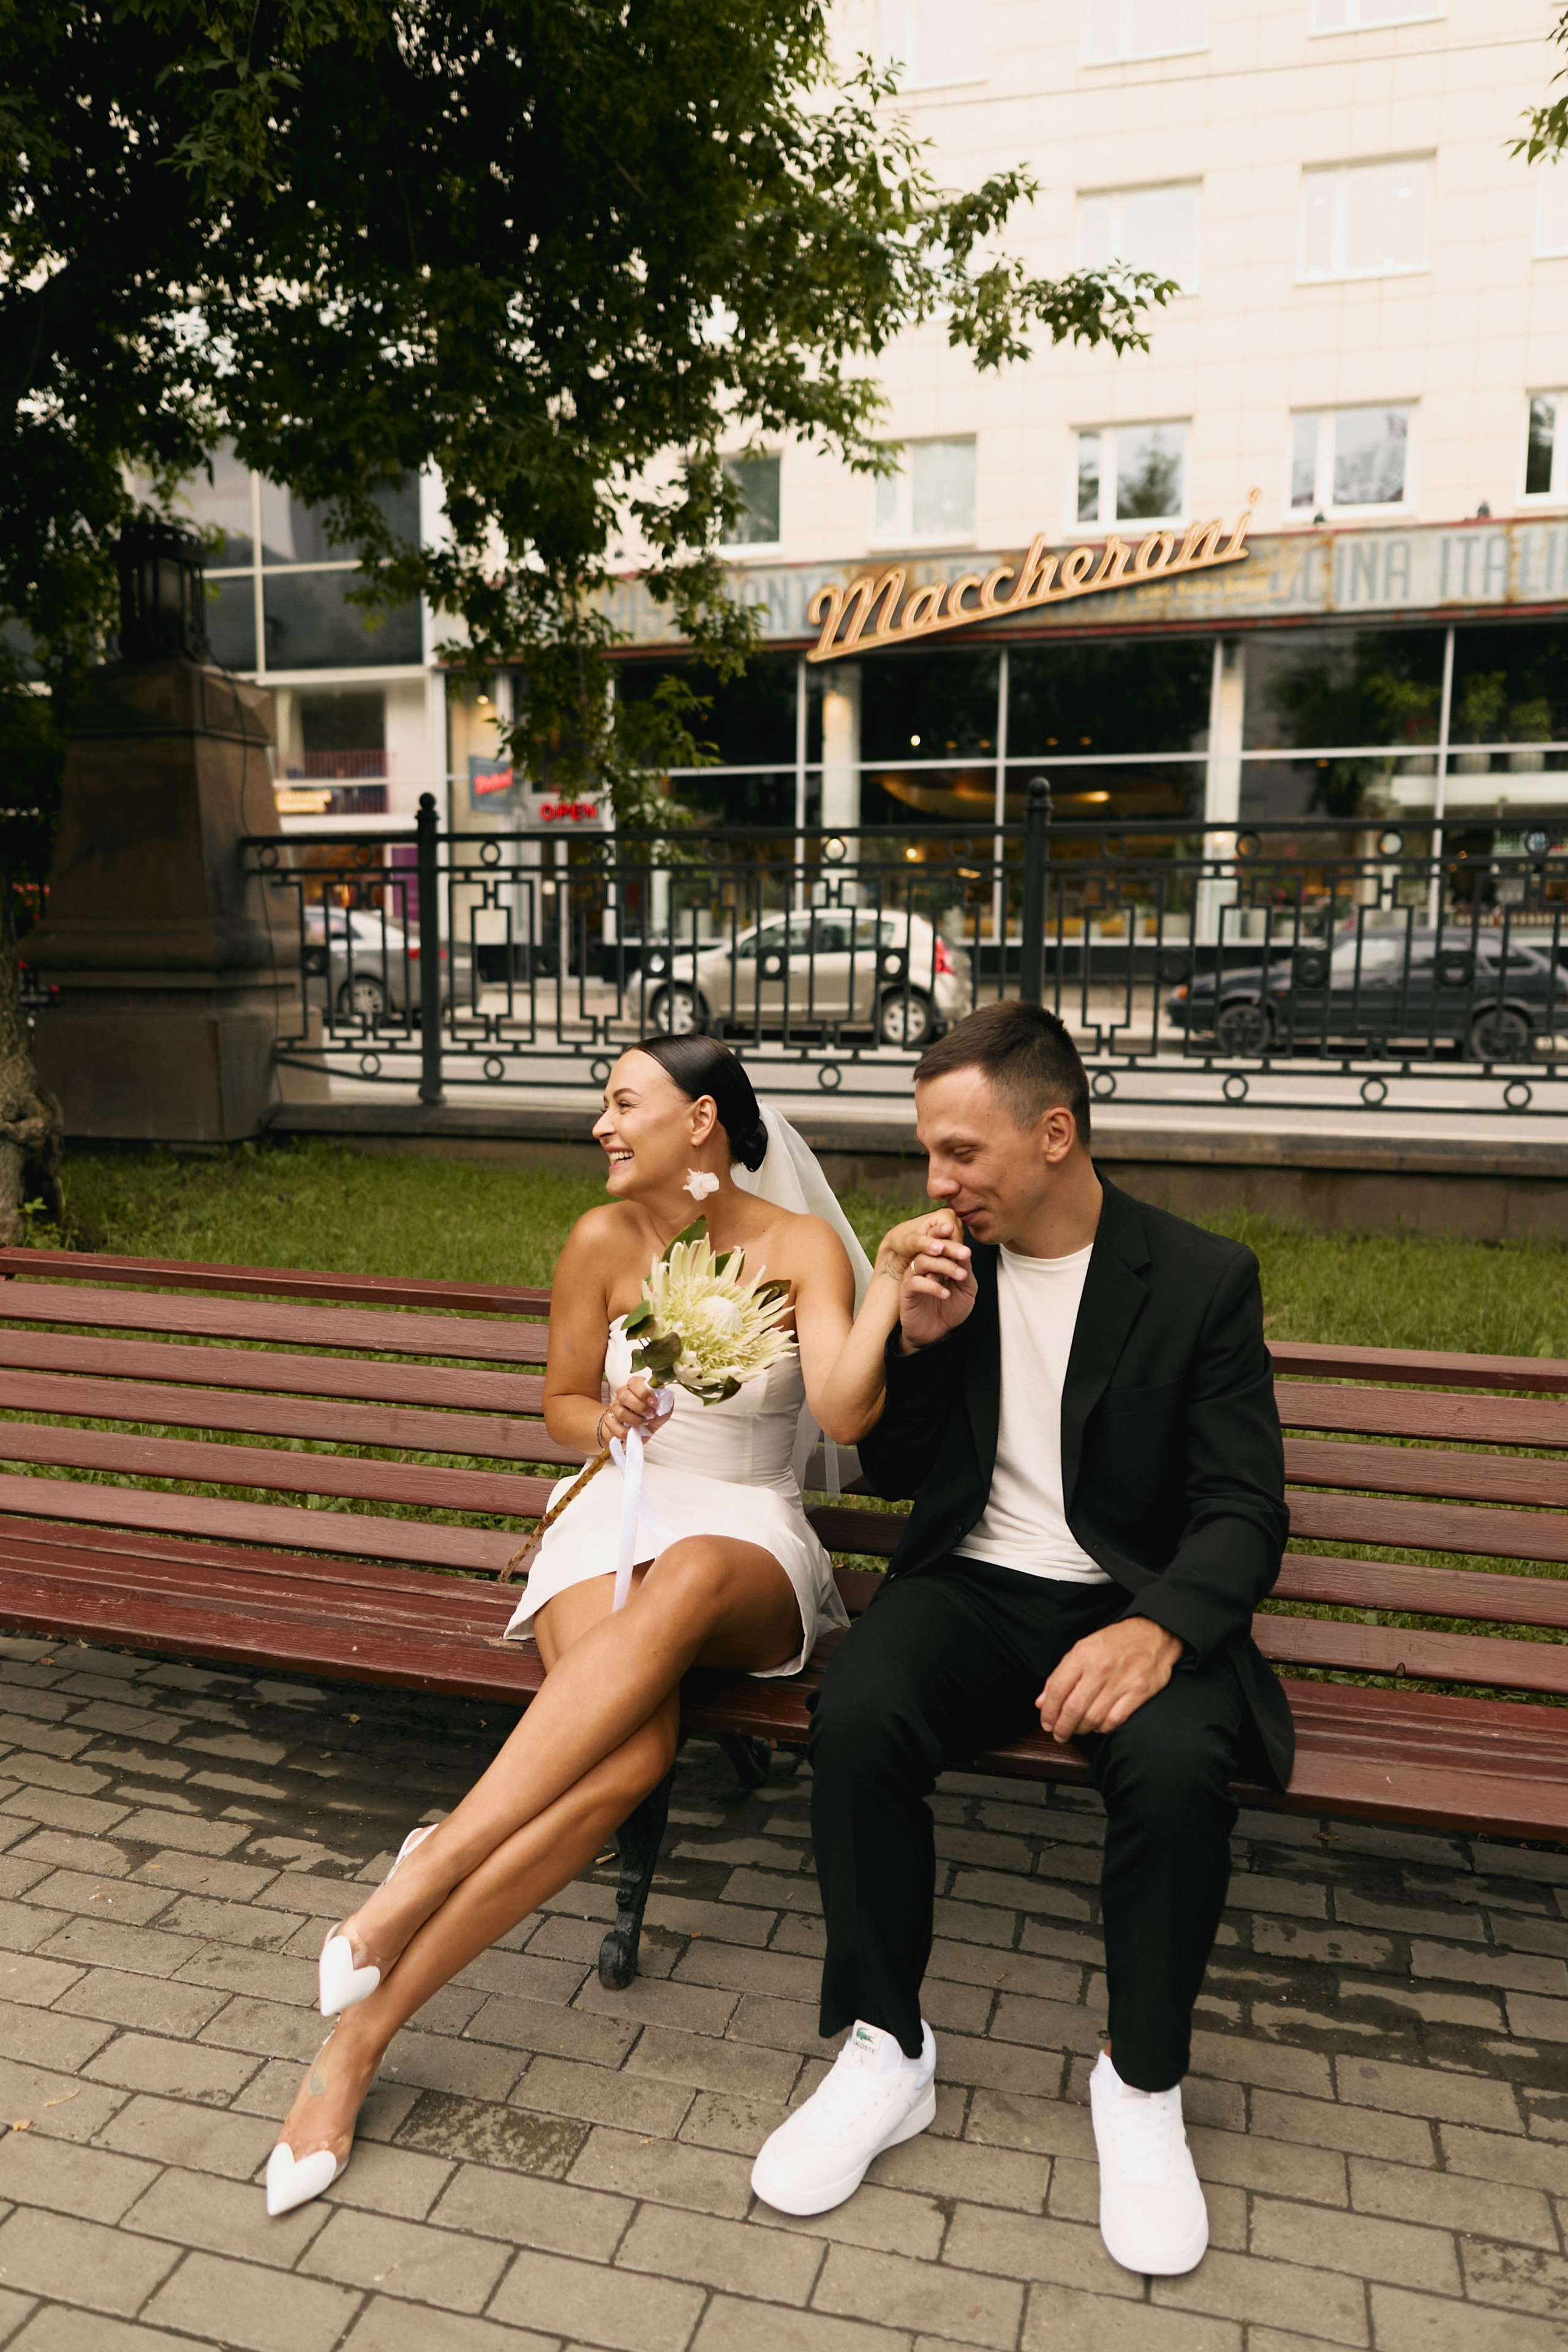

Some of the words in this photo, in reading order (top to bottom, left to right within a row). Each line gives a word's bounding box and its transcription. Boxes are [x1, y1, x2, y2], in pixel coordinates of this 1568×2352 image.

[807, 488, 1262, 663] Maccheroni
[538, 801, 597, 821] OPEN
[853, 2039, 875, 2055] LACOSTE
